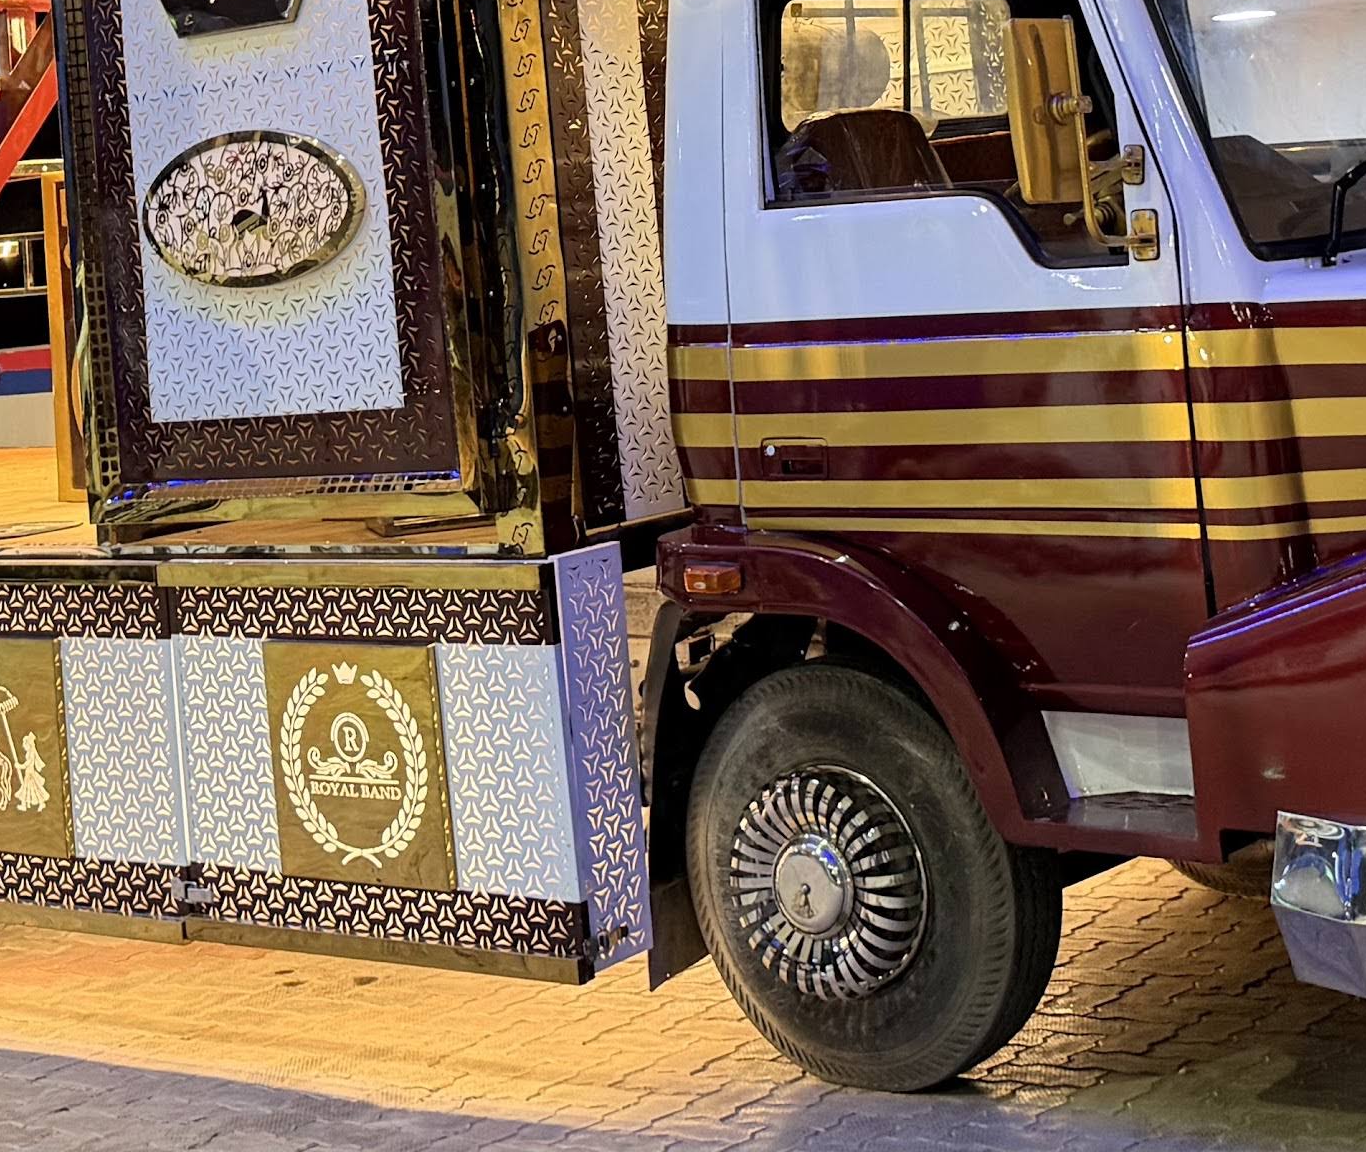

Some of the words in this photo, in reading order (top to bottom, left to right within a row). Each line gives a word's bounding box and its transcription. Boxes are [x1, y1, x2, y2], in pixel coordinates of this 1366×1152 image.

[342, 727, 360, 751] R
[310, 781, 359, 798] ROYAL
[361, 785, 402, 801] BAND
